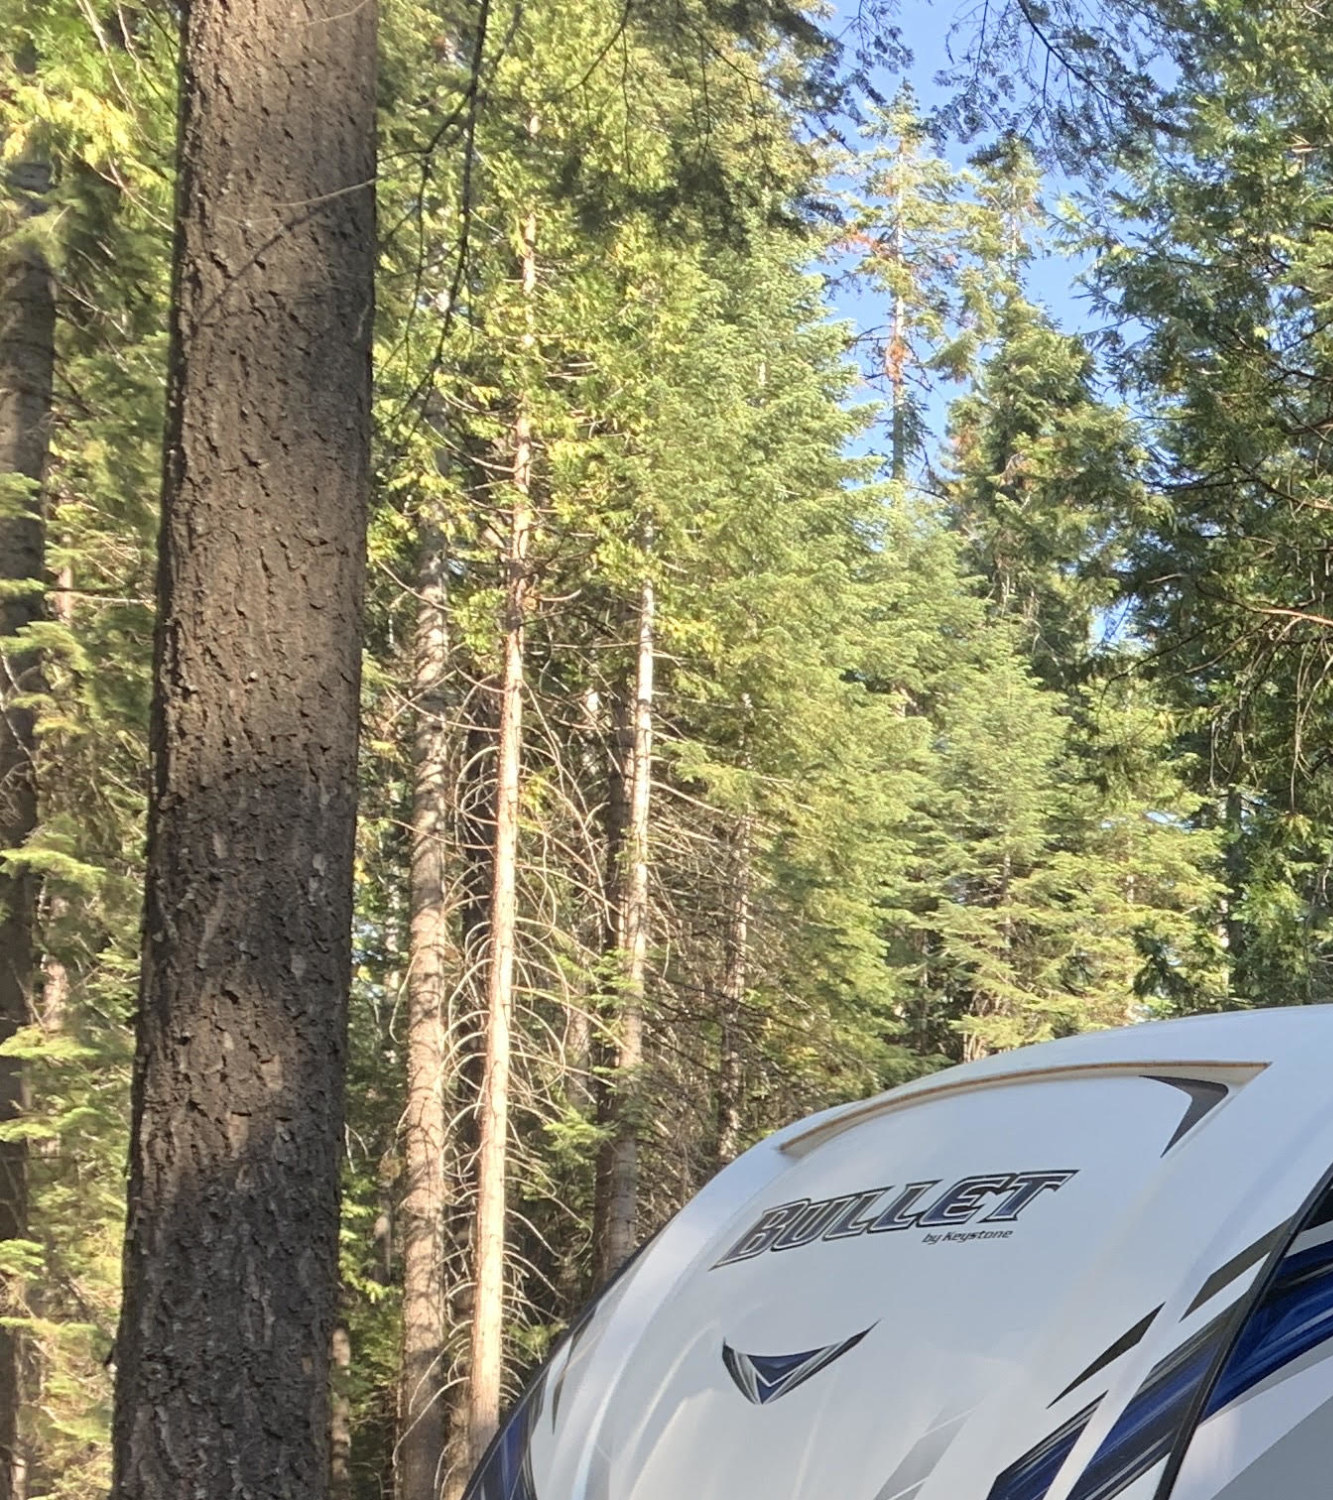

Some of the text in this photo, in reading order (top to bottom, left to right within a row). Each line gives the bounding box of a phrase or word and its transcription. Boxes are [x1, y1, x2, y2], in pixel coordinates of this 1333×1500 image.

[708, 1169, 1081, 1271] BULLET
[921, 1230, 1014, 1245] by Keystone
